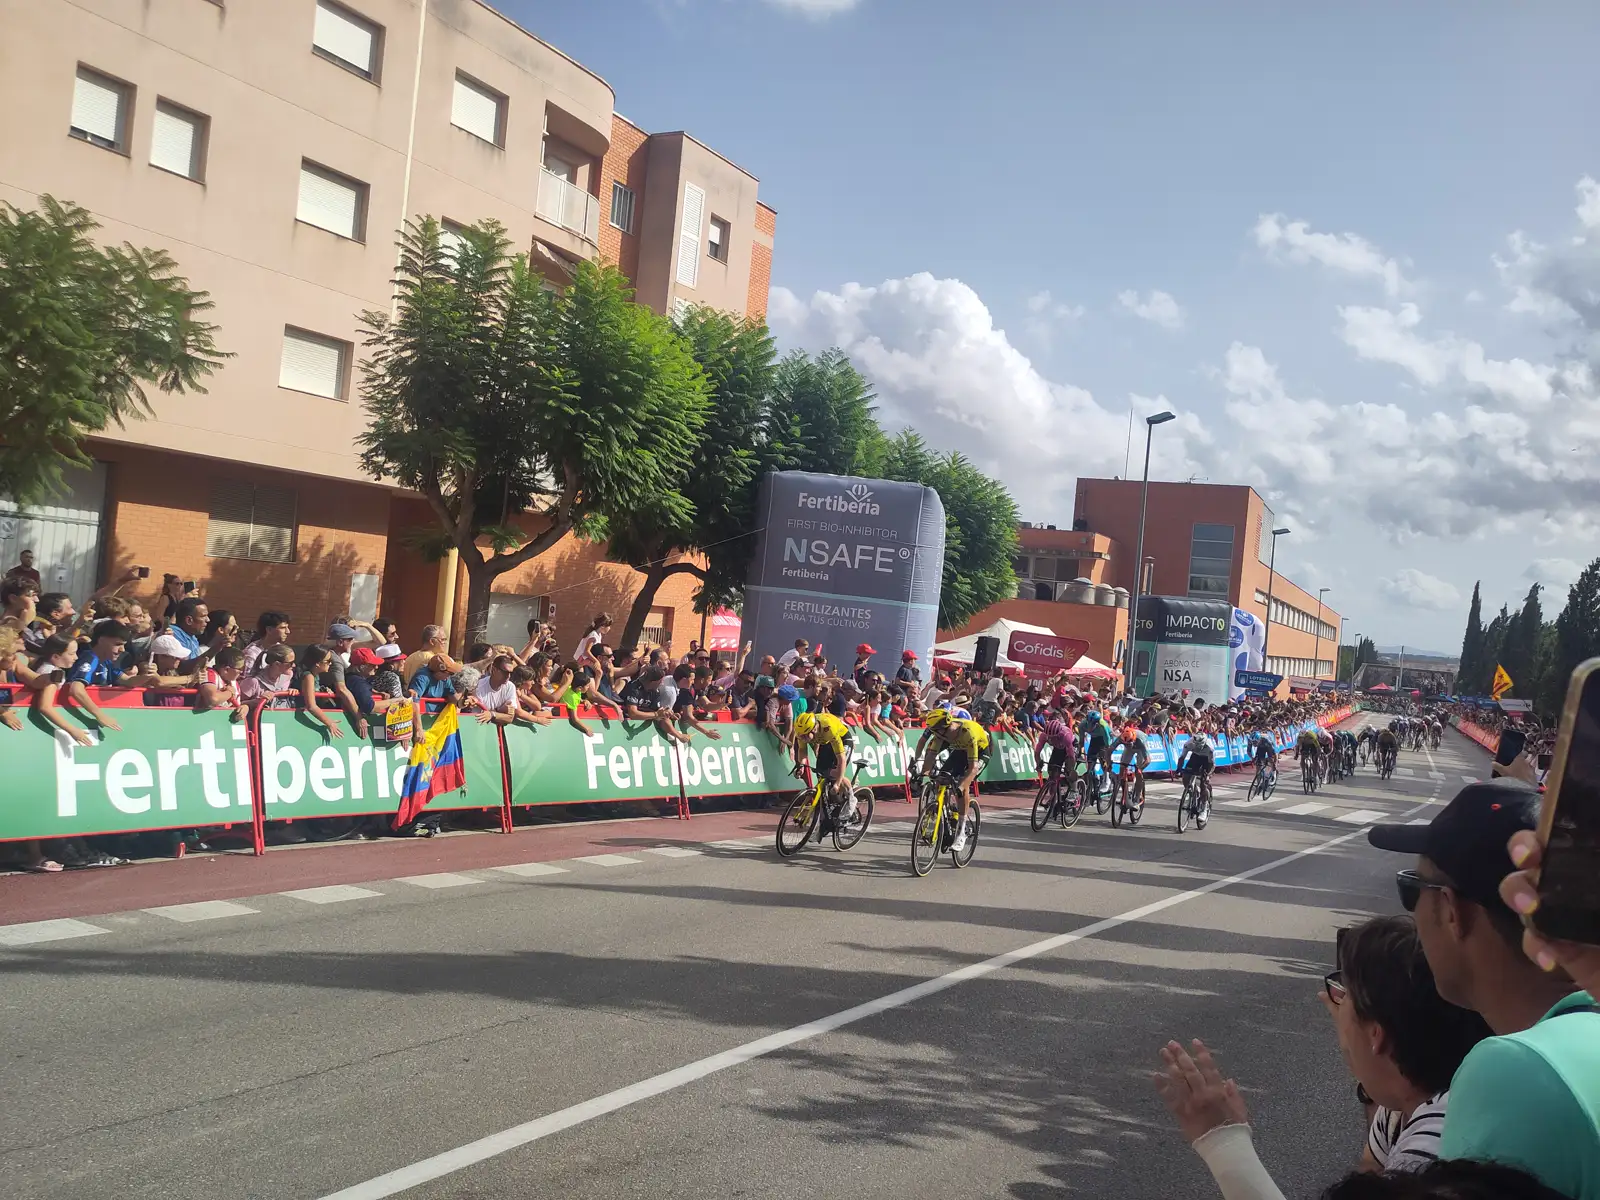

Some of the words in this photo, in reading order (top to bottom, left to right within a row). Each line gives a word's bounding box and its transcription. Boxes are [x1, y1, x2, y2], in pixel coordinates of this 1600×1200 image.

[798, 492, 880, 516] Fertiberia
[787, 519, 816, 531] FIRST
[820, 522, 898, 539] BIO-INHIBITOR
[783, 567, 829, 581] Fertiberia
[784, 600, 872, 620] FERTILIZANTES
[783, 612, 806, 622] PARA
[809, 615, 825, 625] TUS
[827, 616, 871, 630] CULTIVOS
[1165, 631, 1193, 639] Fertiberia
[1013, 640, 1064, 659] Cofidis
[1163, 669, 1192, 682] NSA
[583, 731, 766, 790] Fertiberia
